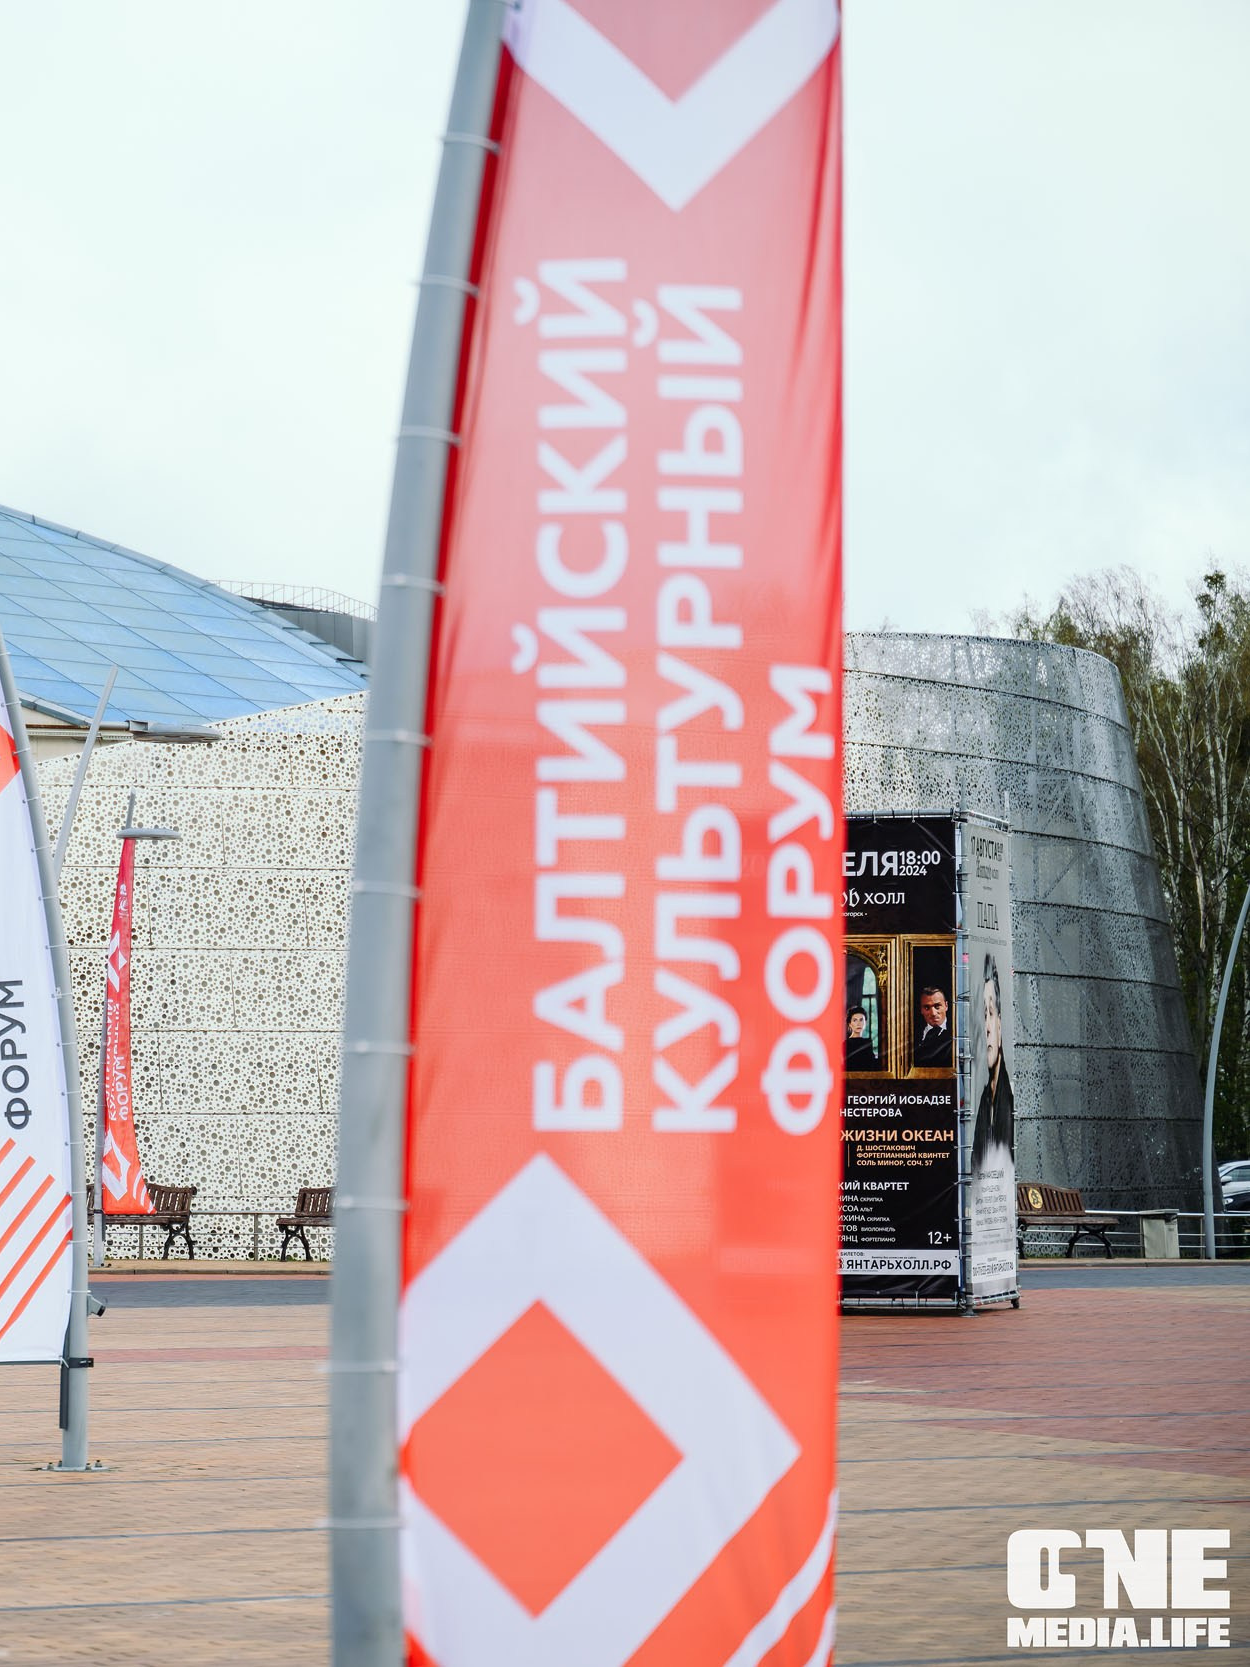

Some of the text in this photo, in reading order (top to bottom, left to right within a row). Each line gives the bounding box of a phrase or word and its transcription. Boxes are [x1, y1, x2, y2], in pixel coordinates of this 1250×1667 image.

[512, 257, 629, 1134] БАЛТИЙСКИЙ
[633, 283, 744, 1135] КУЛЬТУРНЫЙ
[898, 850, 941, 865] 18:00
[898, 865, 928, 876] 2024
[761, 662, 836, 1136] ФОРУМ
[847, 1094, 952, 1106] ГЕОРГИЙ ИОБАДЗЕ
[839, 1108, 903, 1118] НЕСТЕРОВА
[839, 1129, 955, 1142] ЖИЗНИ ОКЕАН
[856, 1151, 917, 1159] ФОРТЕПИАННЫЙ
[877, 1159, 906, 1168] МИНОР,
[863, 1181, 910, 1191] КВАРТЕТ
[927, 1231, 953, 1245] 12+
[846, 1259, 953, 1271] ЯНТАРЬХОЛЛ.РФ
